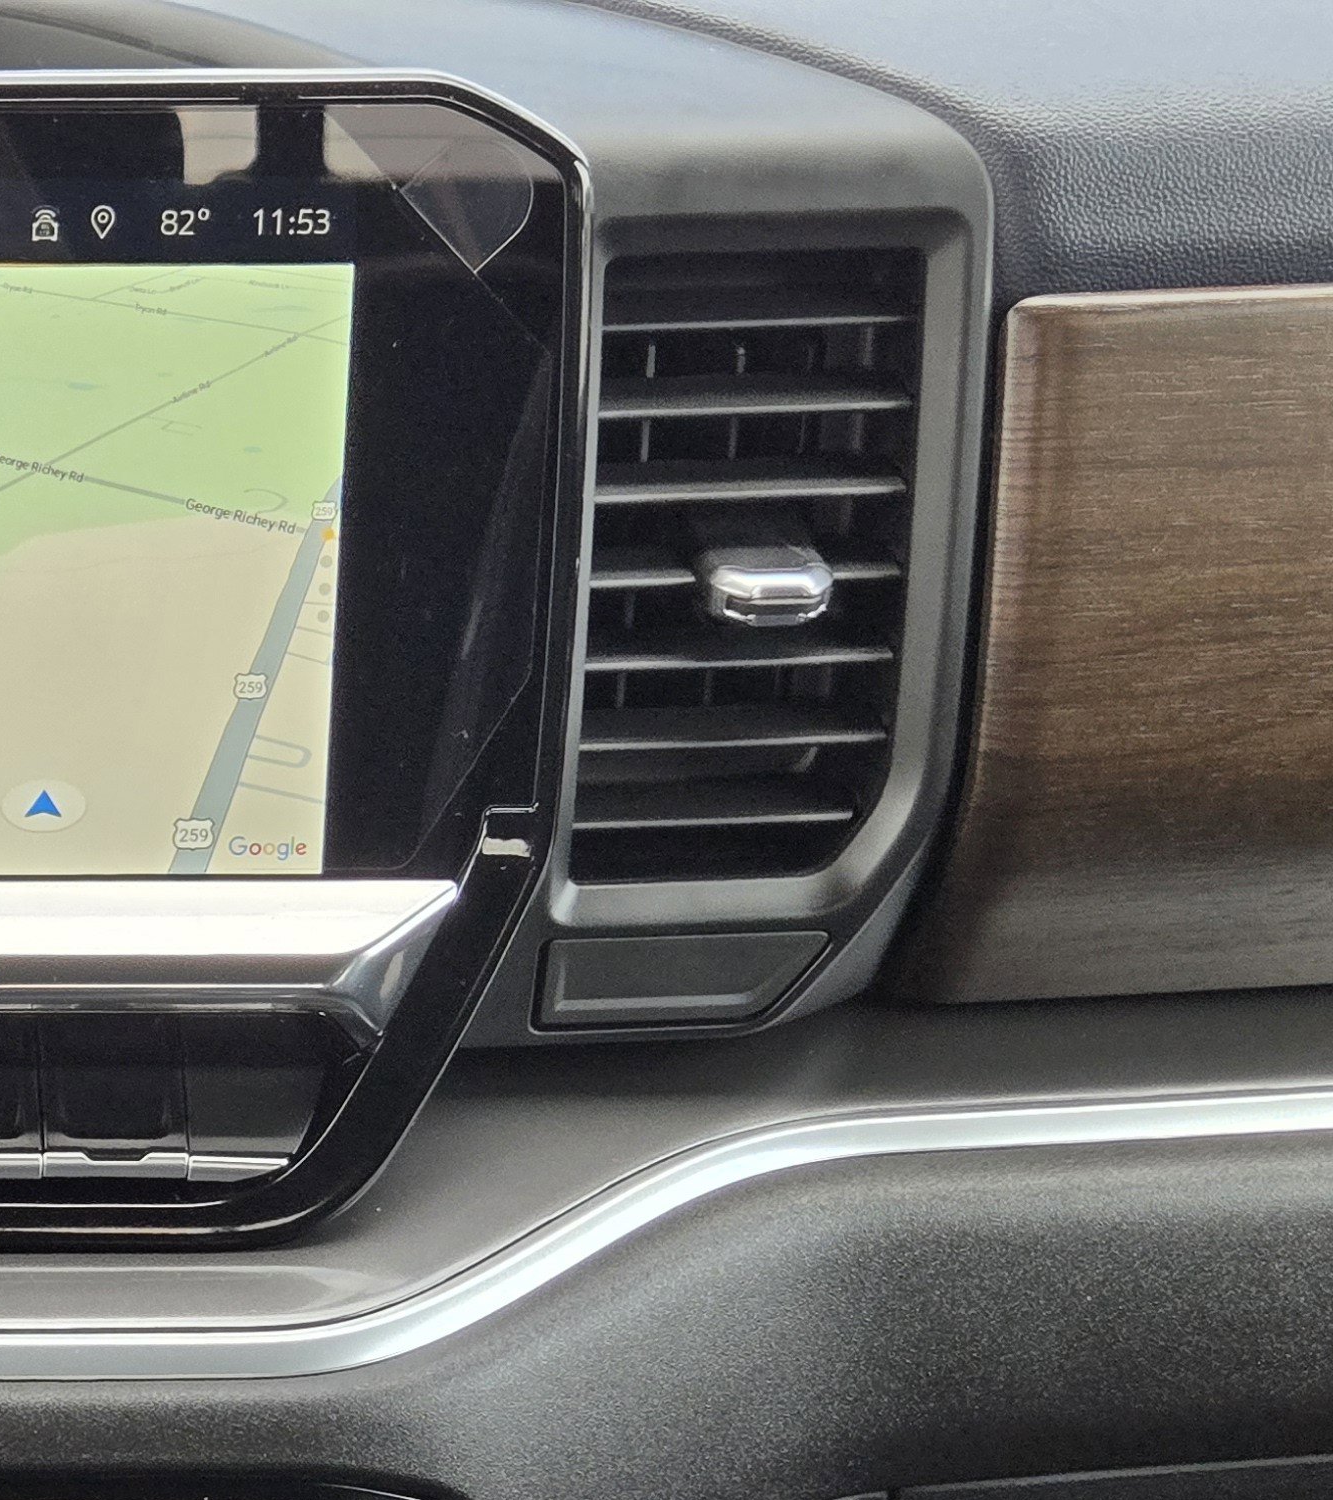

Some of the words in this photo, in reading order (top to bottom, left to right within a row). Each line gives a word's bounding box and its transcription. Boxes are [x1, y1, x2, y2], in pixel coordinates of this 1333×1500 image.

[252, 207, 331, 236] 11:53
[32, 461, 67, 481] Richey
[69, 470, 84, 482] Rd
[185, 498, 230, 520] George
[232, 510, 276, 532] Richey
[277, 519, 297, 535] Rd
[237, 681, 263, 694] 259
[179, 828, 209, 843] 259
[228, 836, 307, 861] Google
